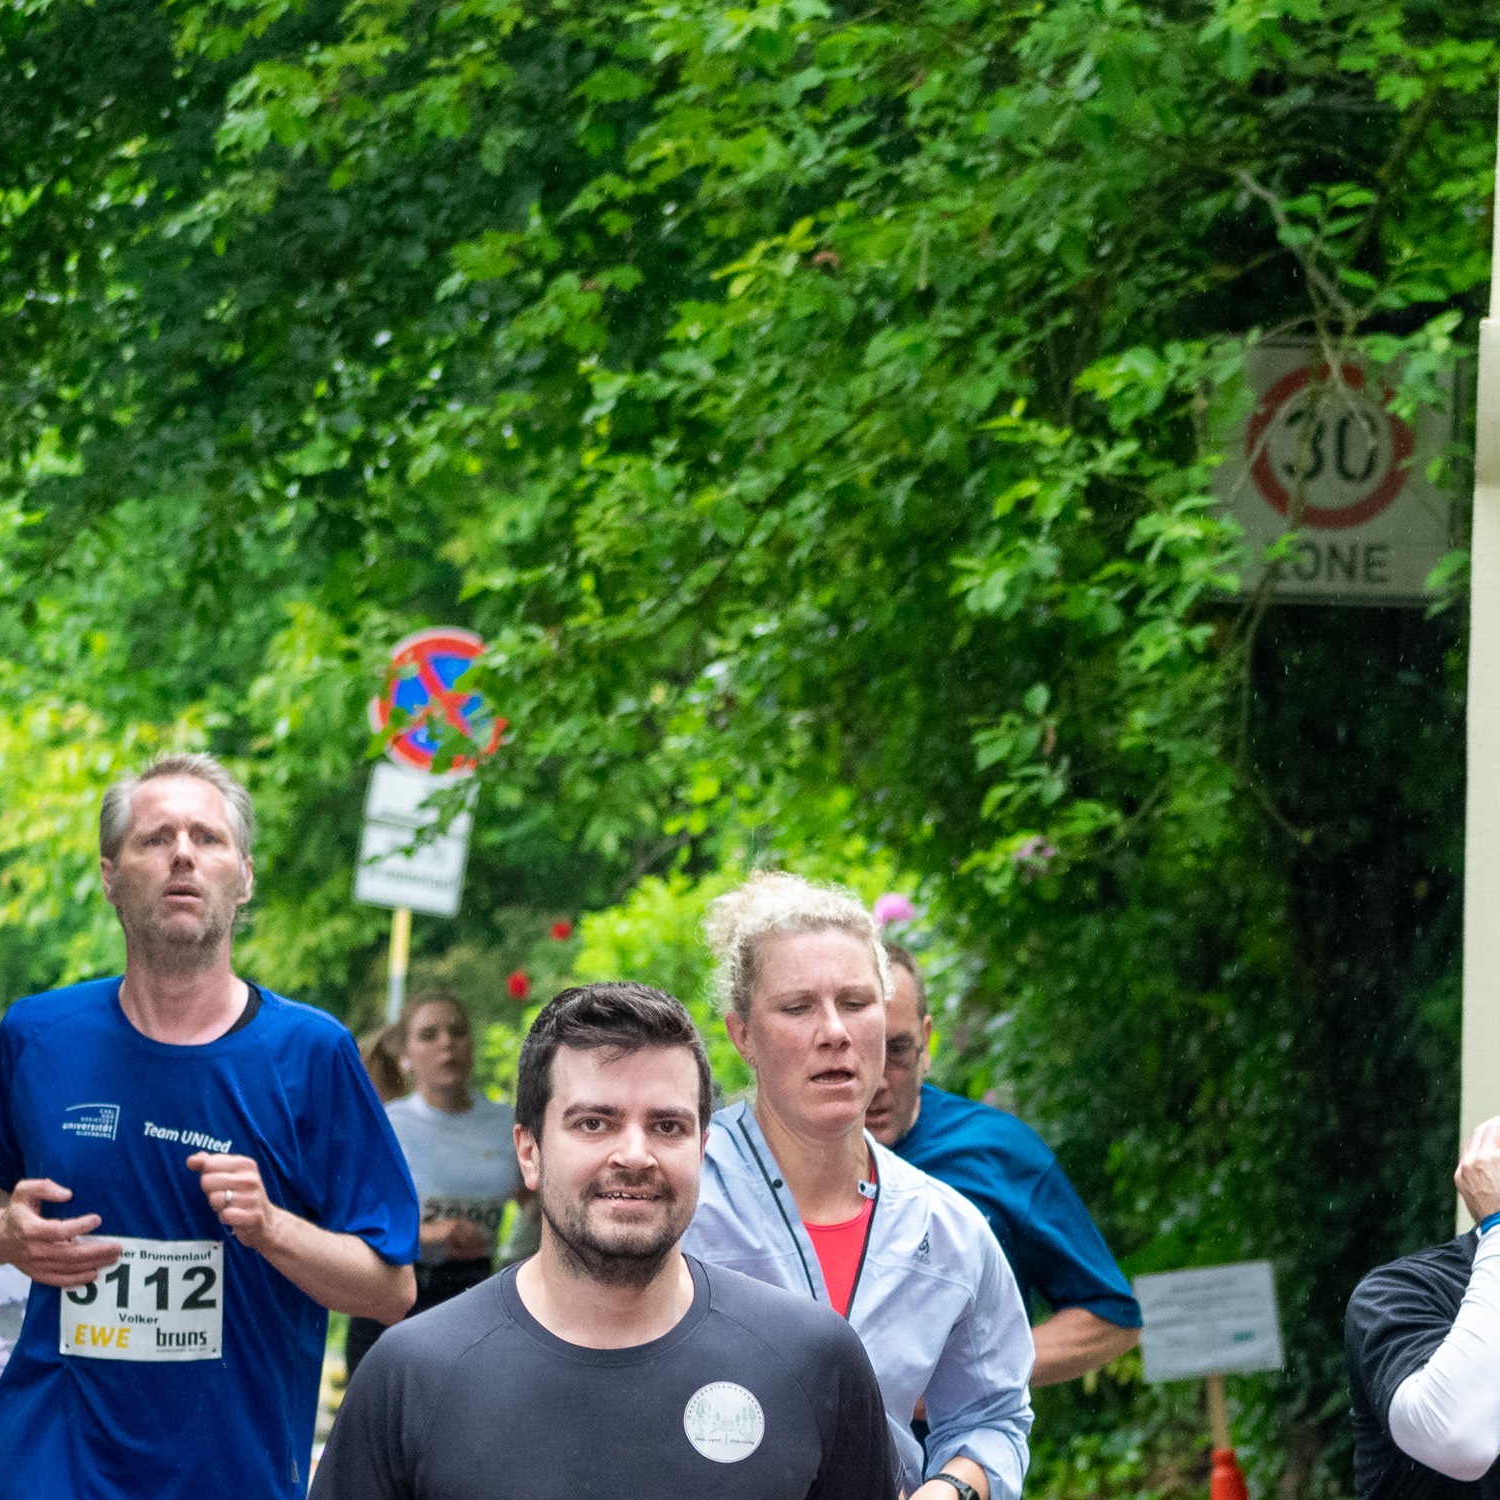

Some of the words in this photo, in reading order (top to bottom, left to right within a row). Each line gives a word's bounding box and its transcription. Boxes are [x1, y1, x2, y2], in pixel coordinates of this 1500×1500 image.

[1284, 411, 1378, 483] 30
[1274, 541, 1390, 583] ONE
[144, 1121, 178, 1142] Team
[140, 1251, 212, 1263] Brunnenlauf
[119, 1313, 159, 1324] Volker
[74, 1323, 131, 1349] EWE
[156, 1327, 207, 1347] bruns
